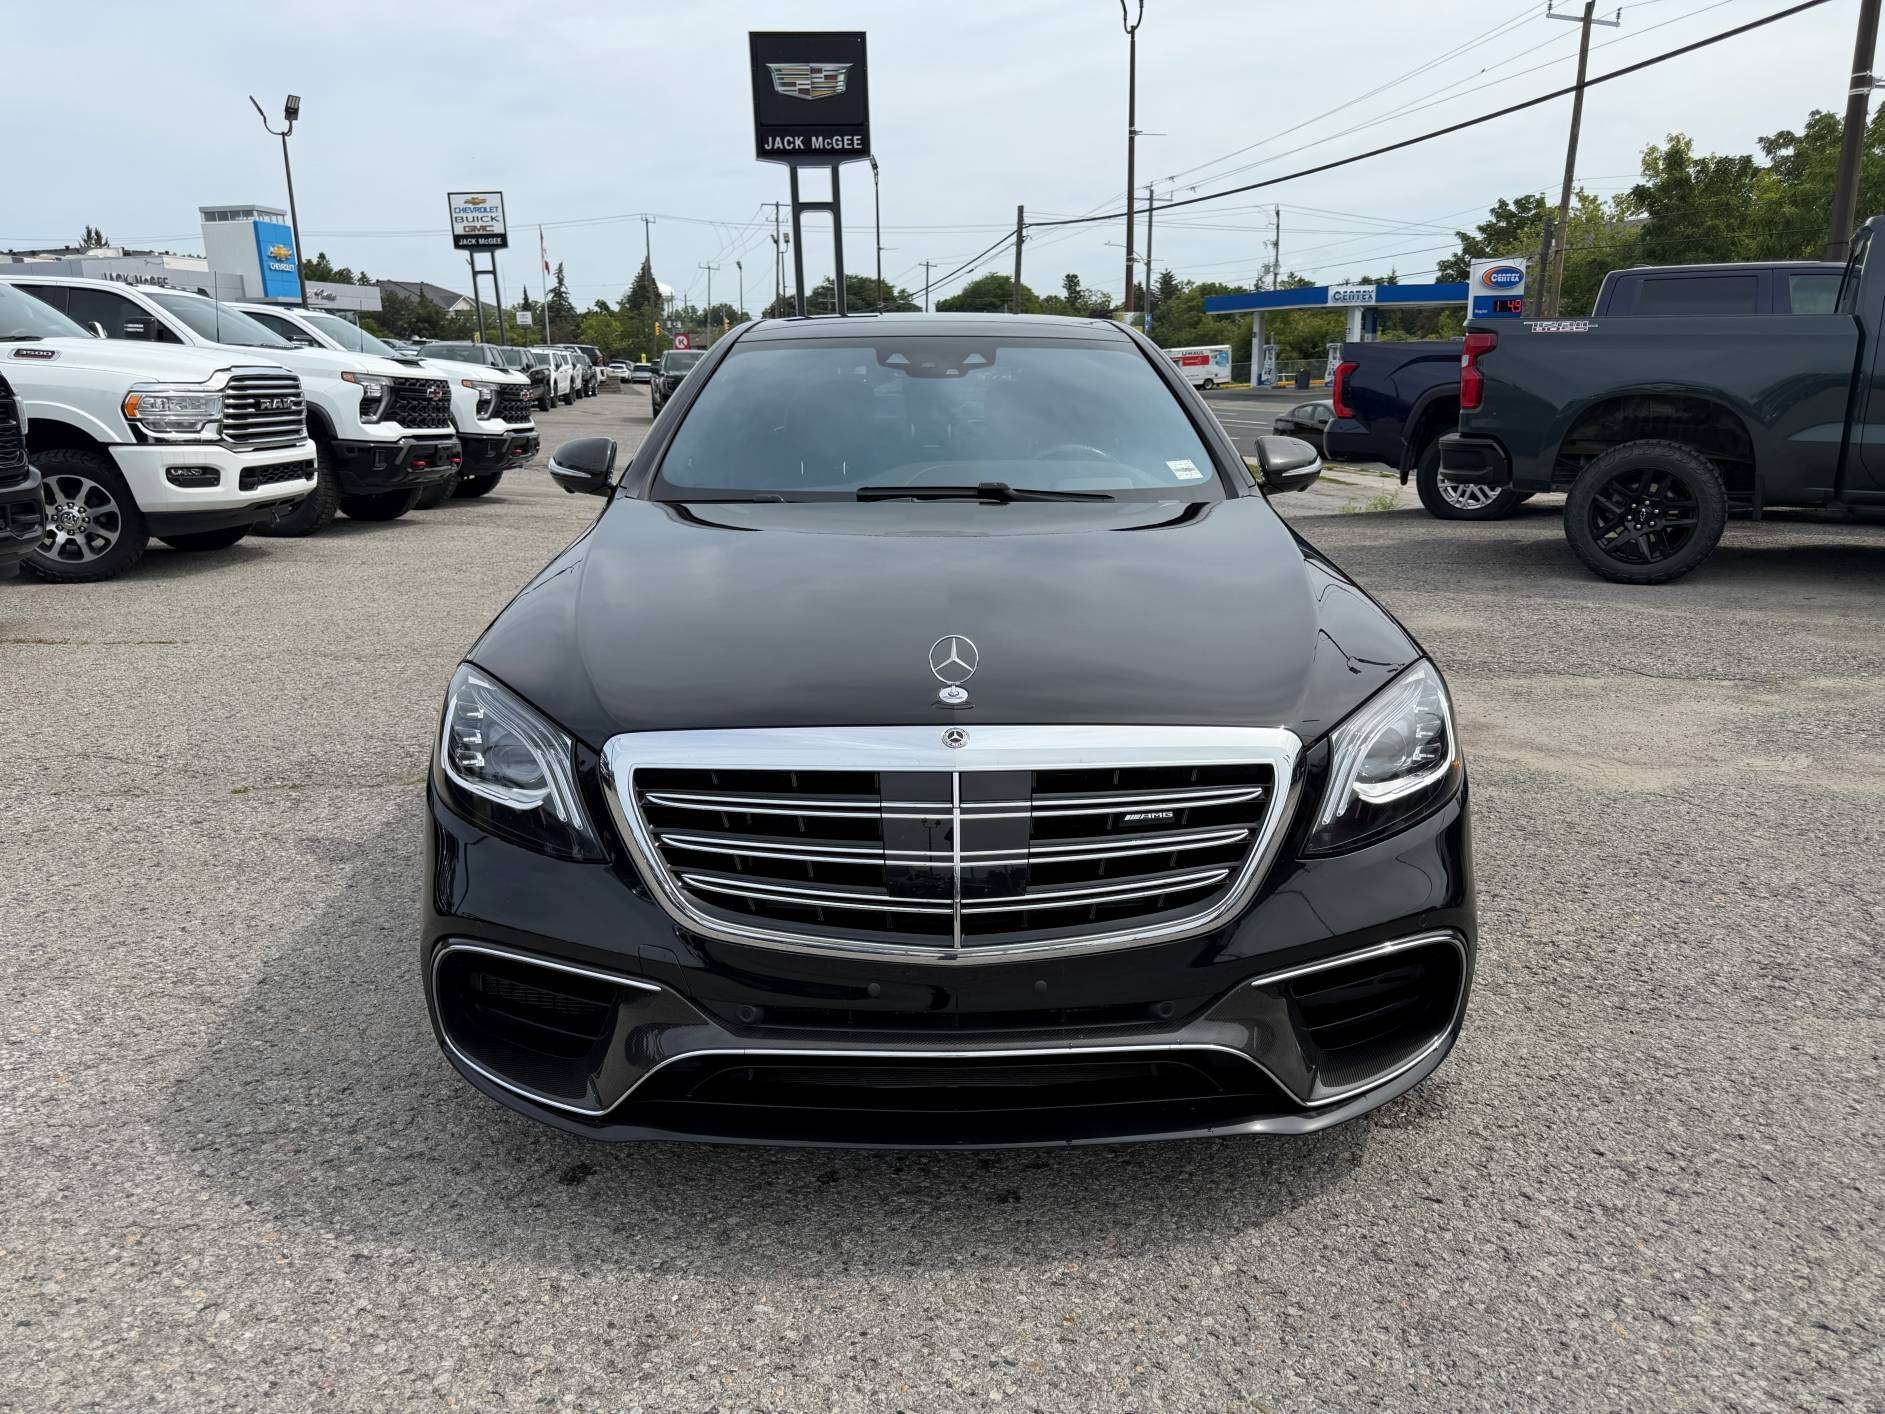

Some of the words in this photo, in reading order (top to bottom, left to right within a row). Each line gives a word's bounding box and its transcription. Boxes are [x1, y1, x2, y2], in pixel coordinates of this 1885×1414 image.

[764, 136, 804, 150] JACK
[811, 135, 863, 149] McGEE
[454, 215, 499, 223] BUICK
[459, 238, 477, 246] JACK
[478, 237, 502, 245] McGEE
[1491, 273, 1520, 281] CENTEX
[1333, 290, 1374, 301] CENTEX
